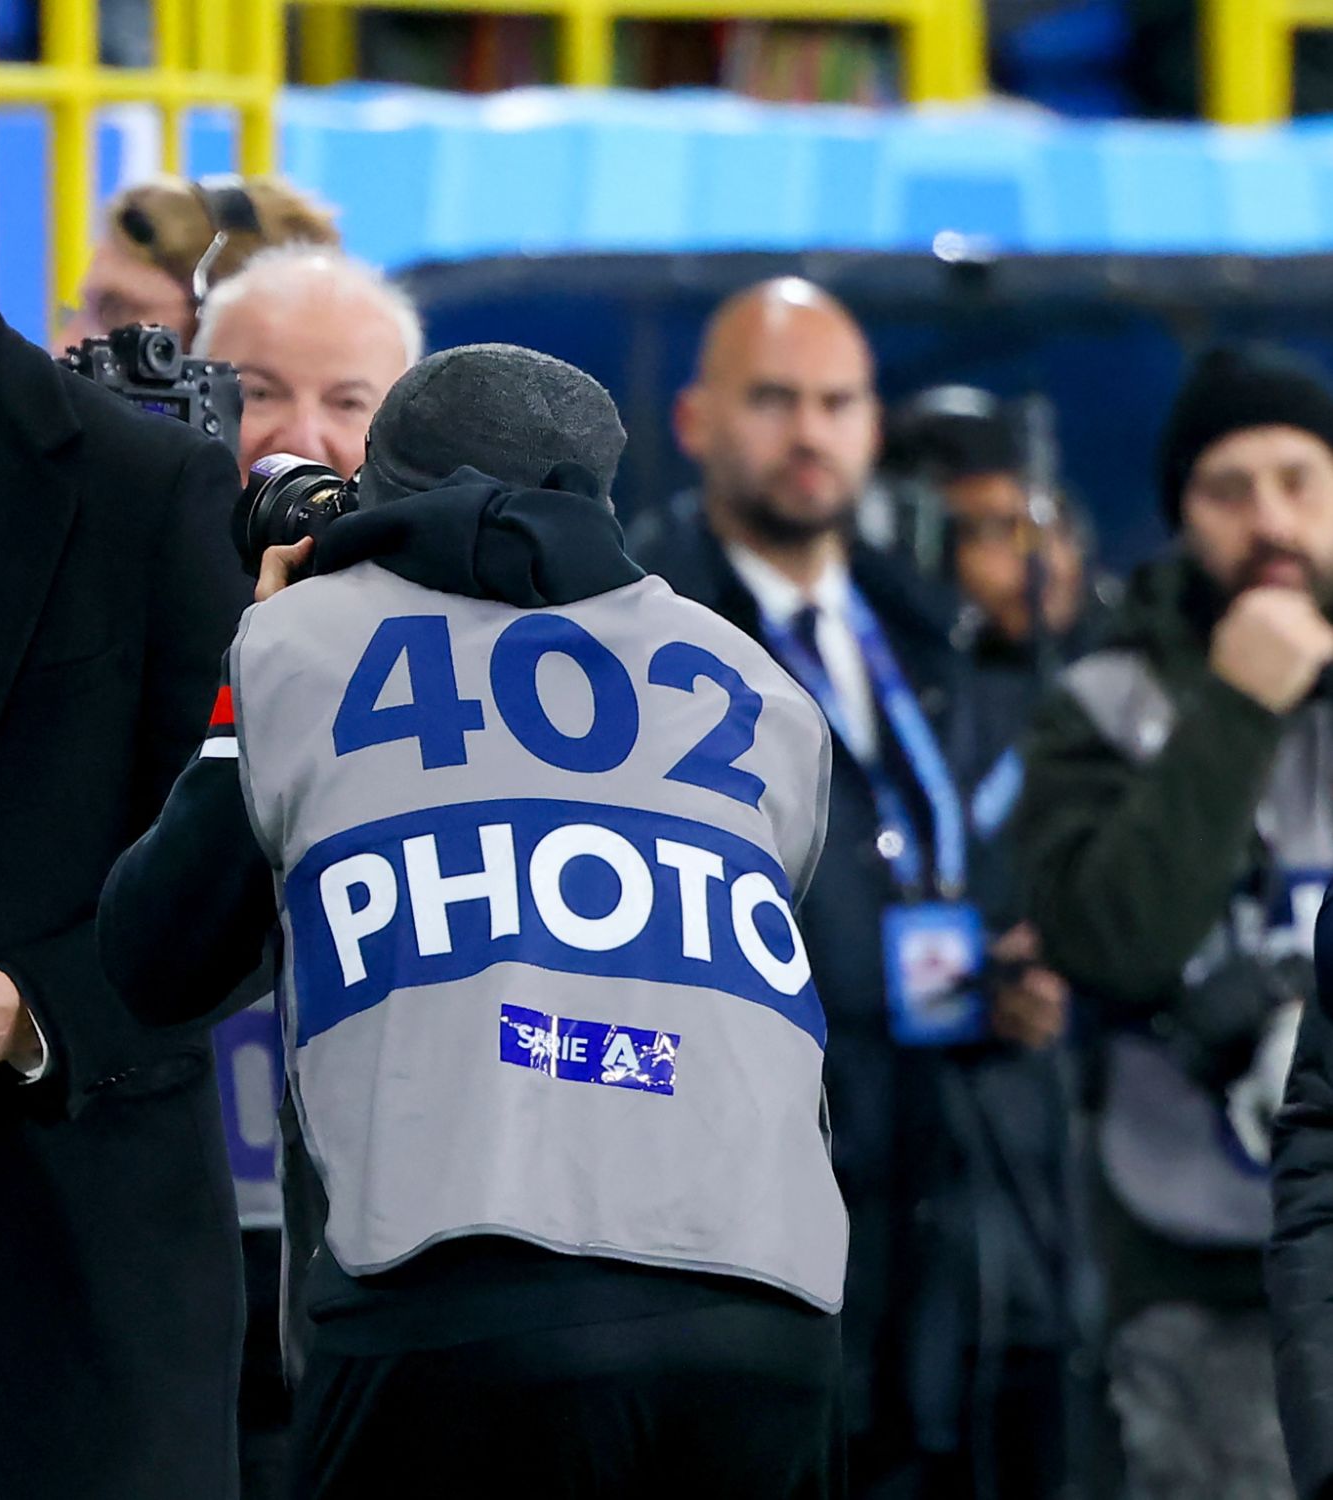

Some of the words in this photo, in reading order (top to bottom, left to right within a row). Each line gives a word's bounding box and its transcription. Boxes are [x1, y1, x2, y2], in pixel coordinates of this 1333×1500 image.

[332, 612, 767, 811] 402
[318, 822, 813, 997] PHOTO
[600, 1032, 641, 1083] A
